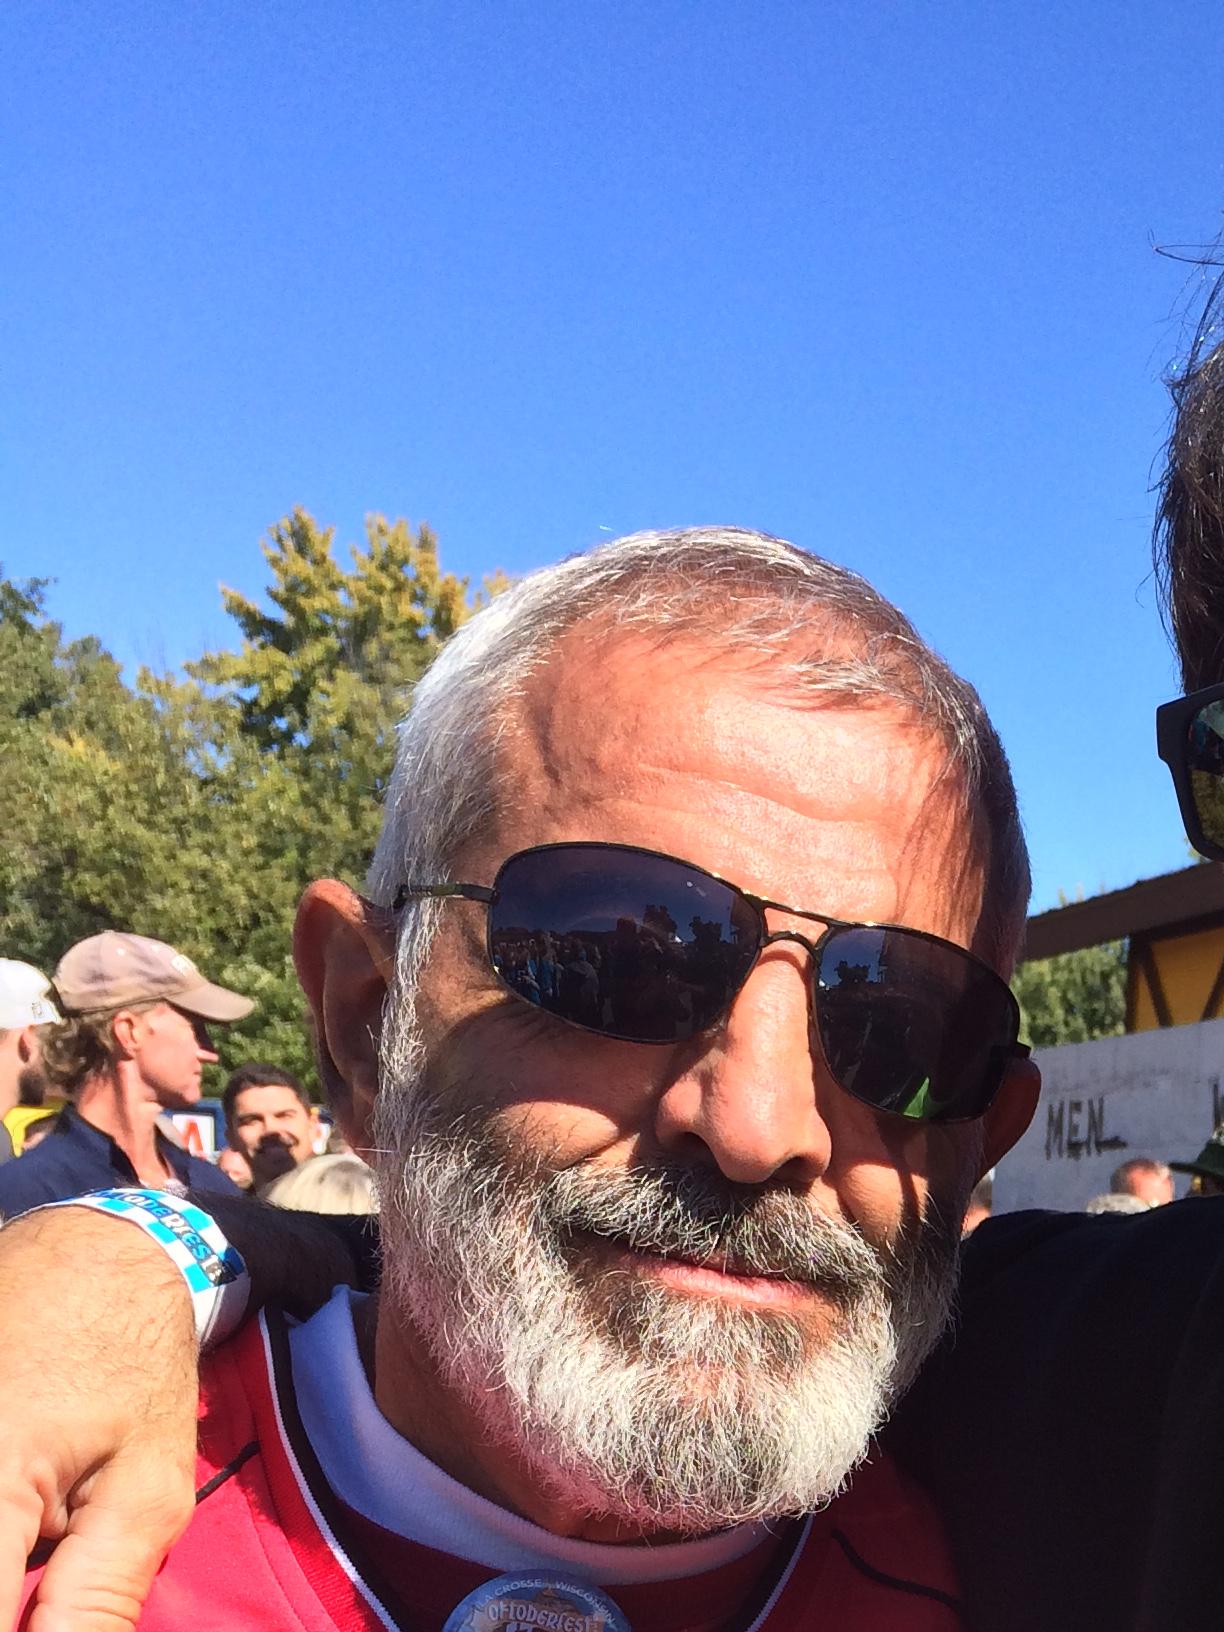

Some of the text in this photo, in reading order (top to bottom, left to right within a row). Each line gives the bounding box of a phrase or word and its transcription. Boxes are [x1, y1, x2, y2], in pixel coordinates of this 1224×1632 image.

[1046, 1098, 1105, 1160] MEN
[494, 1578, 543, 1596] CROSSE
[555, 1580, 616, 1625] WISCONSIN
